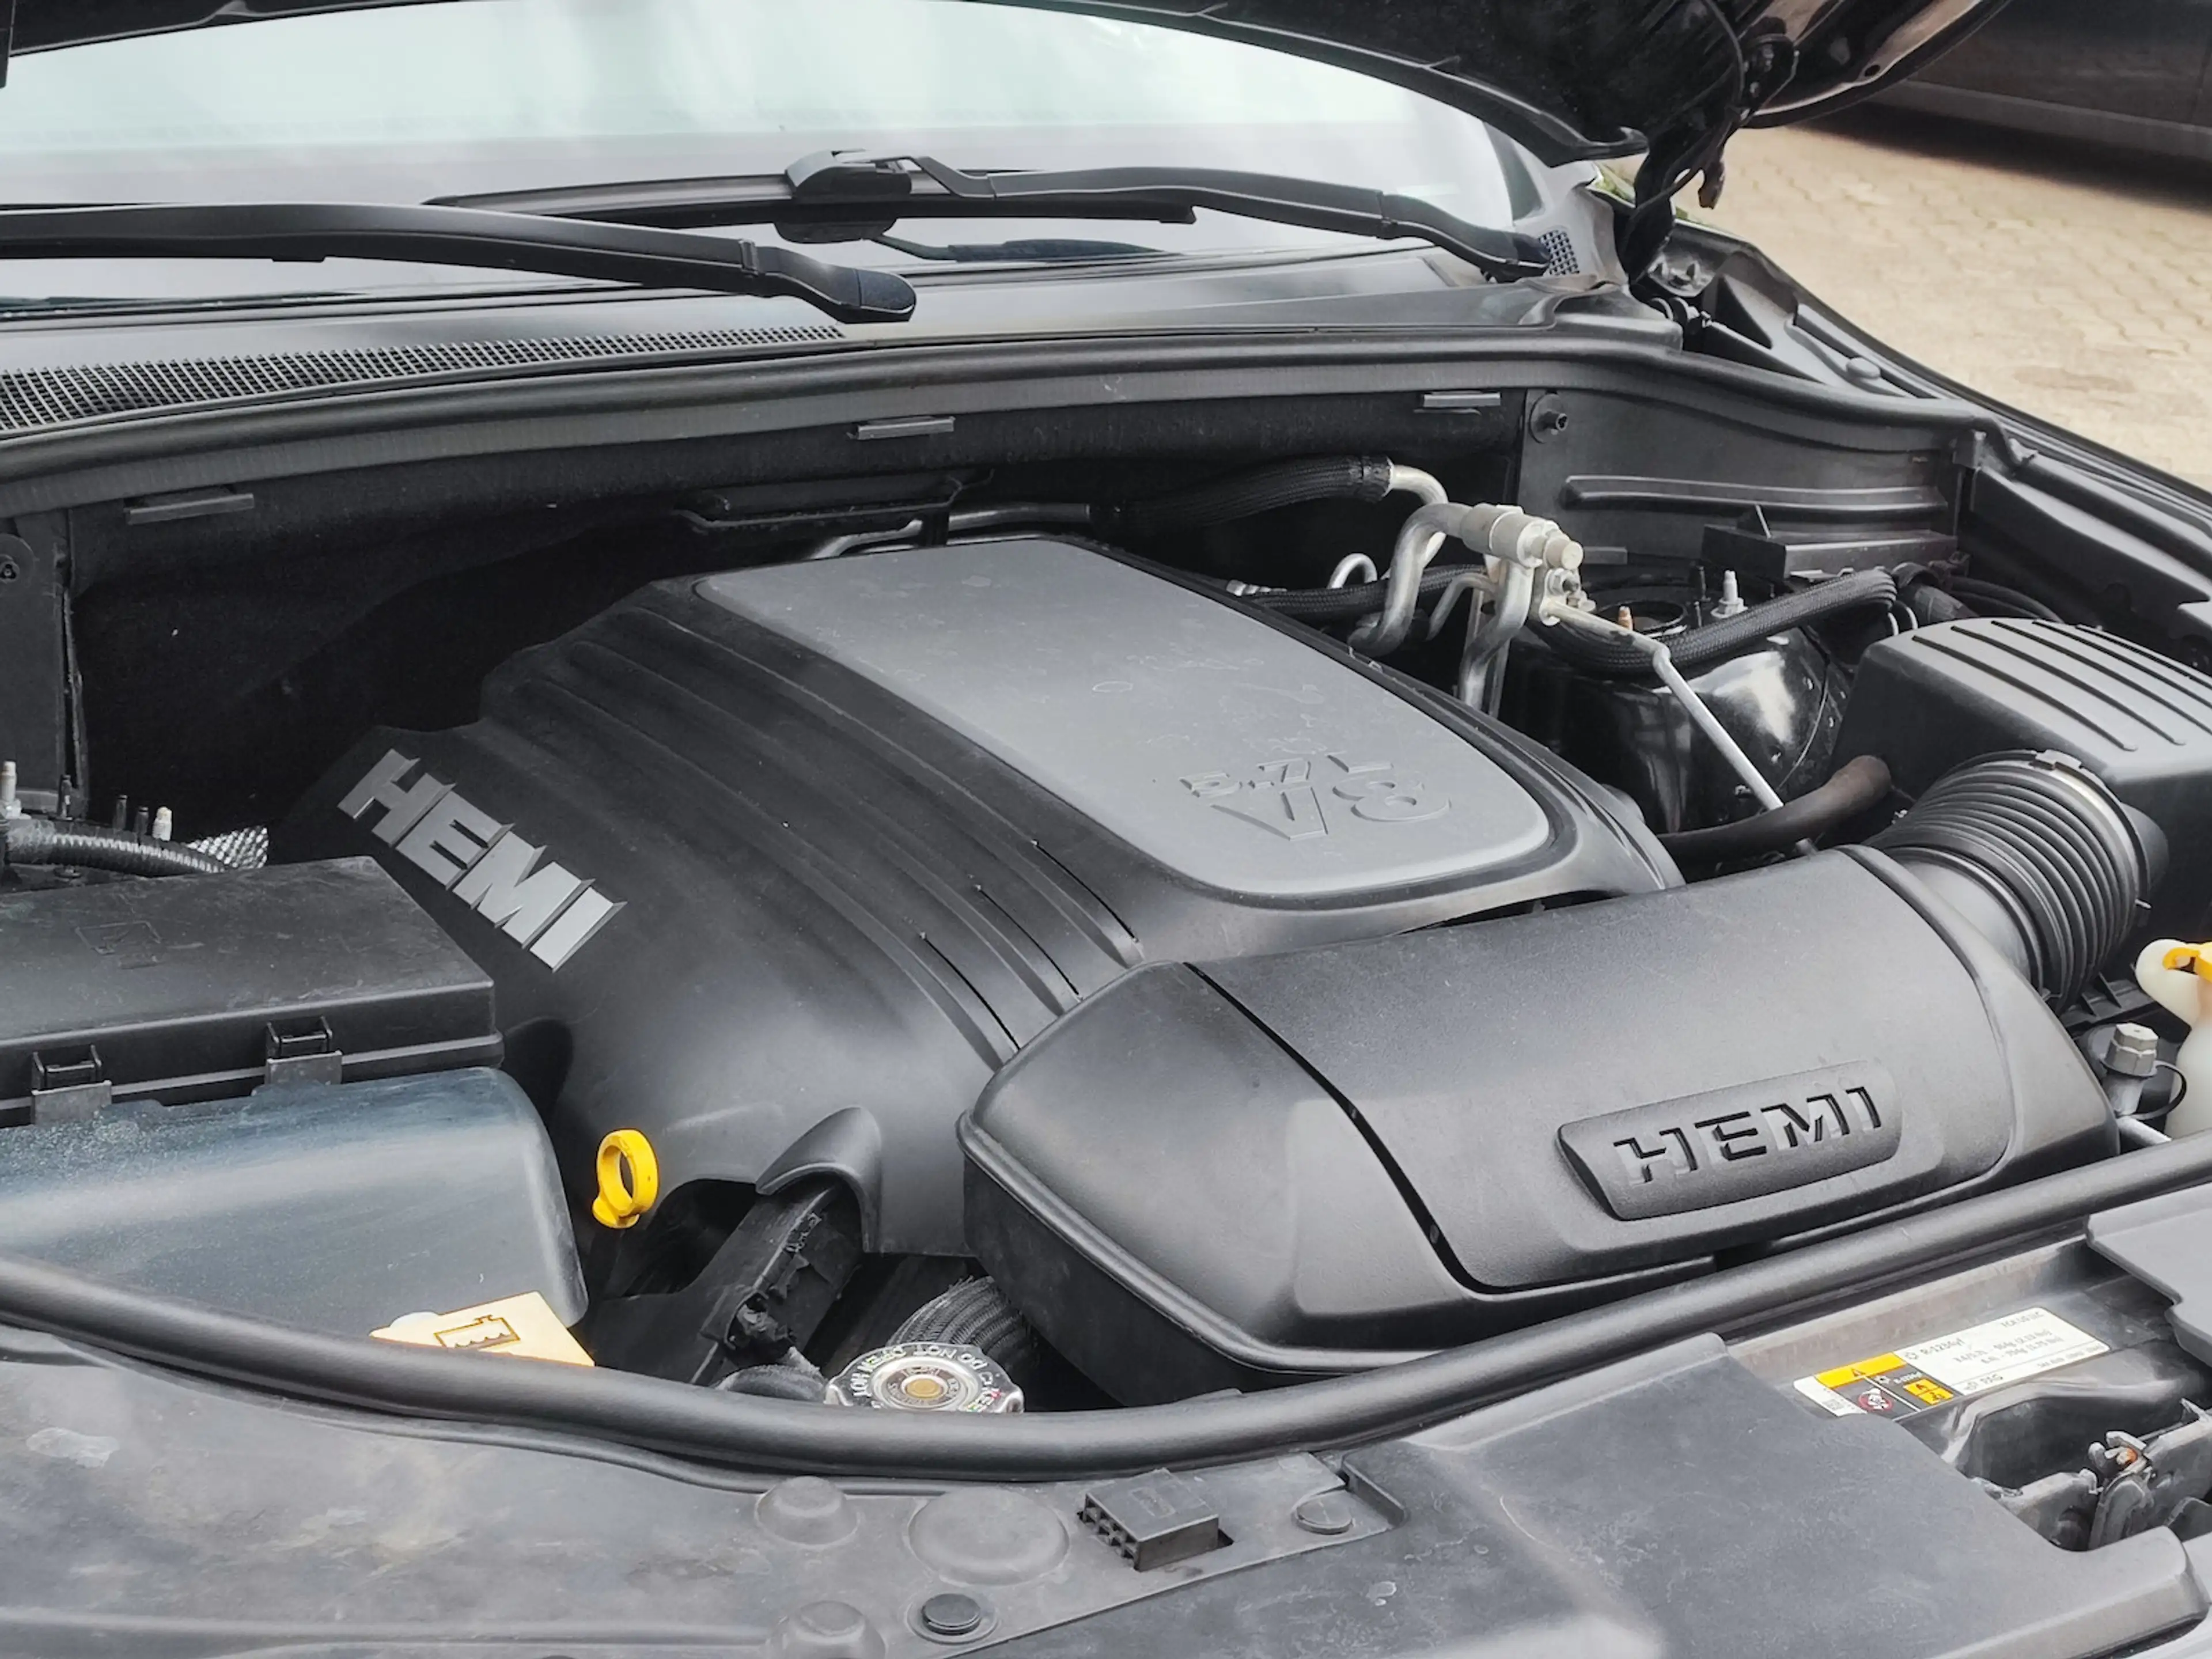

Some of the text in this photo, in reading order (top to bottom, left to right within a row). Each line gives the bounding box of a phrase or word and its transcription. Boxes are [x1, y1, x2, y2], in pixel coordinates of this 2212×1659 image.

[1210, 778, 1453, 842] V8
[338, 748, 628, 973] HEMI
[1612, 1086, 1882, 1184] HEMI
[912, 1345, 958, 1359] NOT
[958, 1353, 988, 1370] DO
